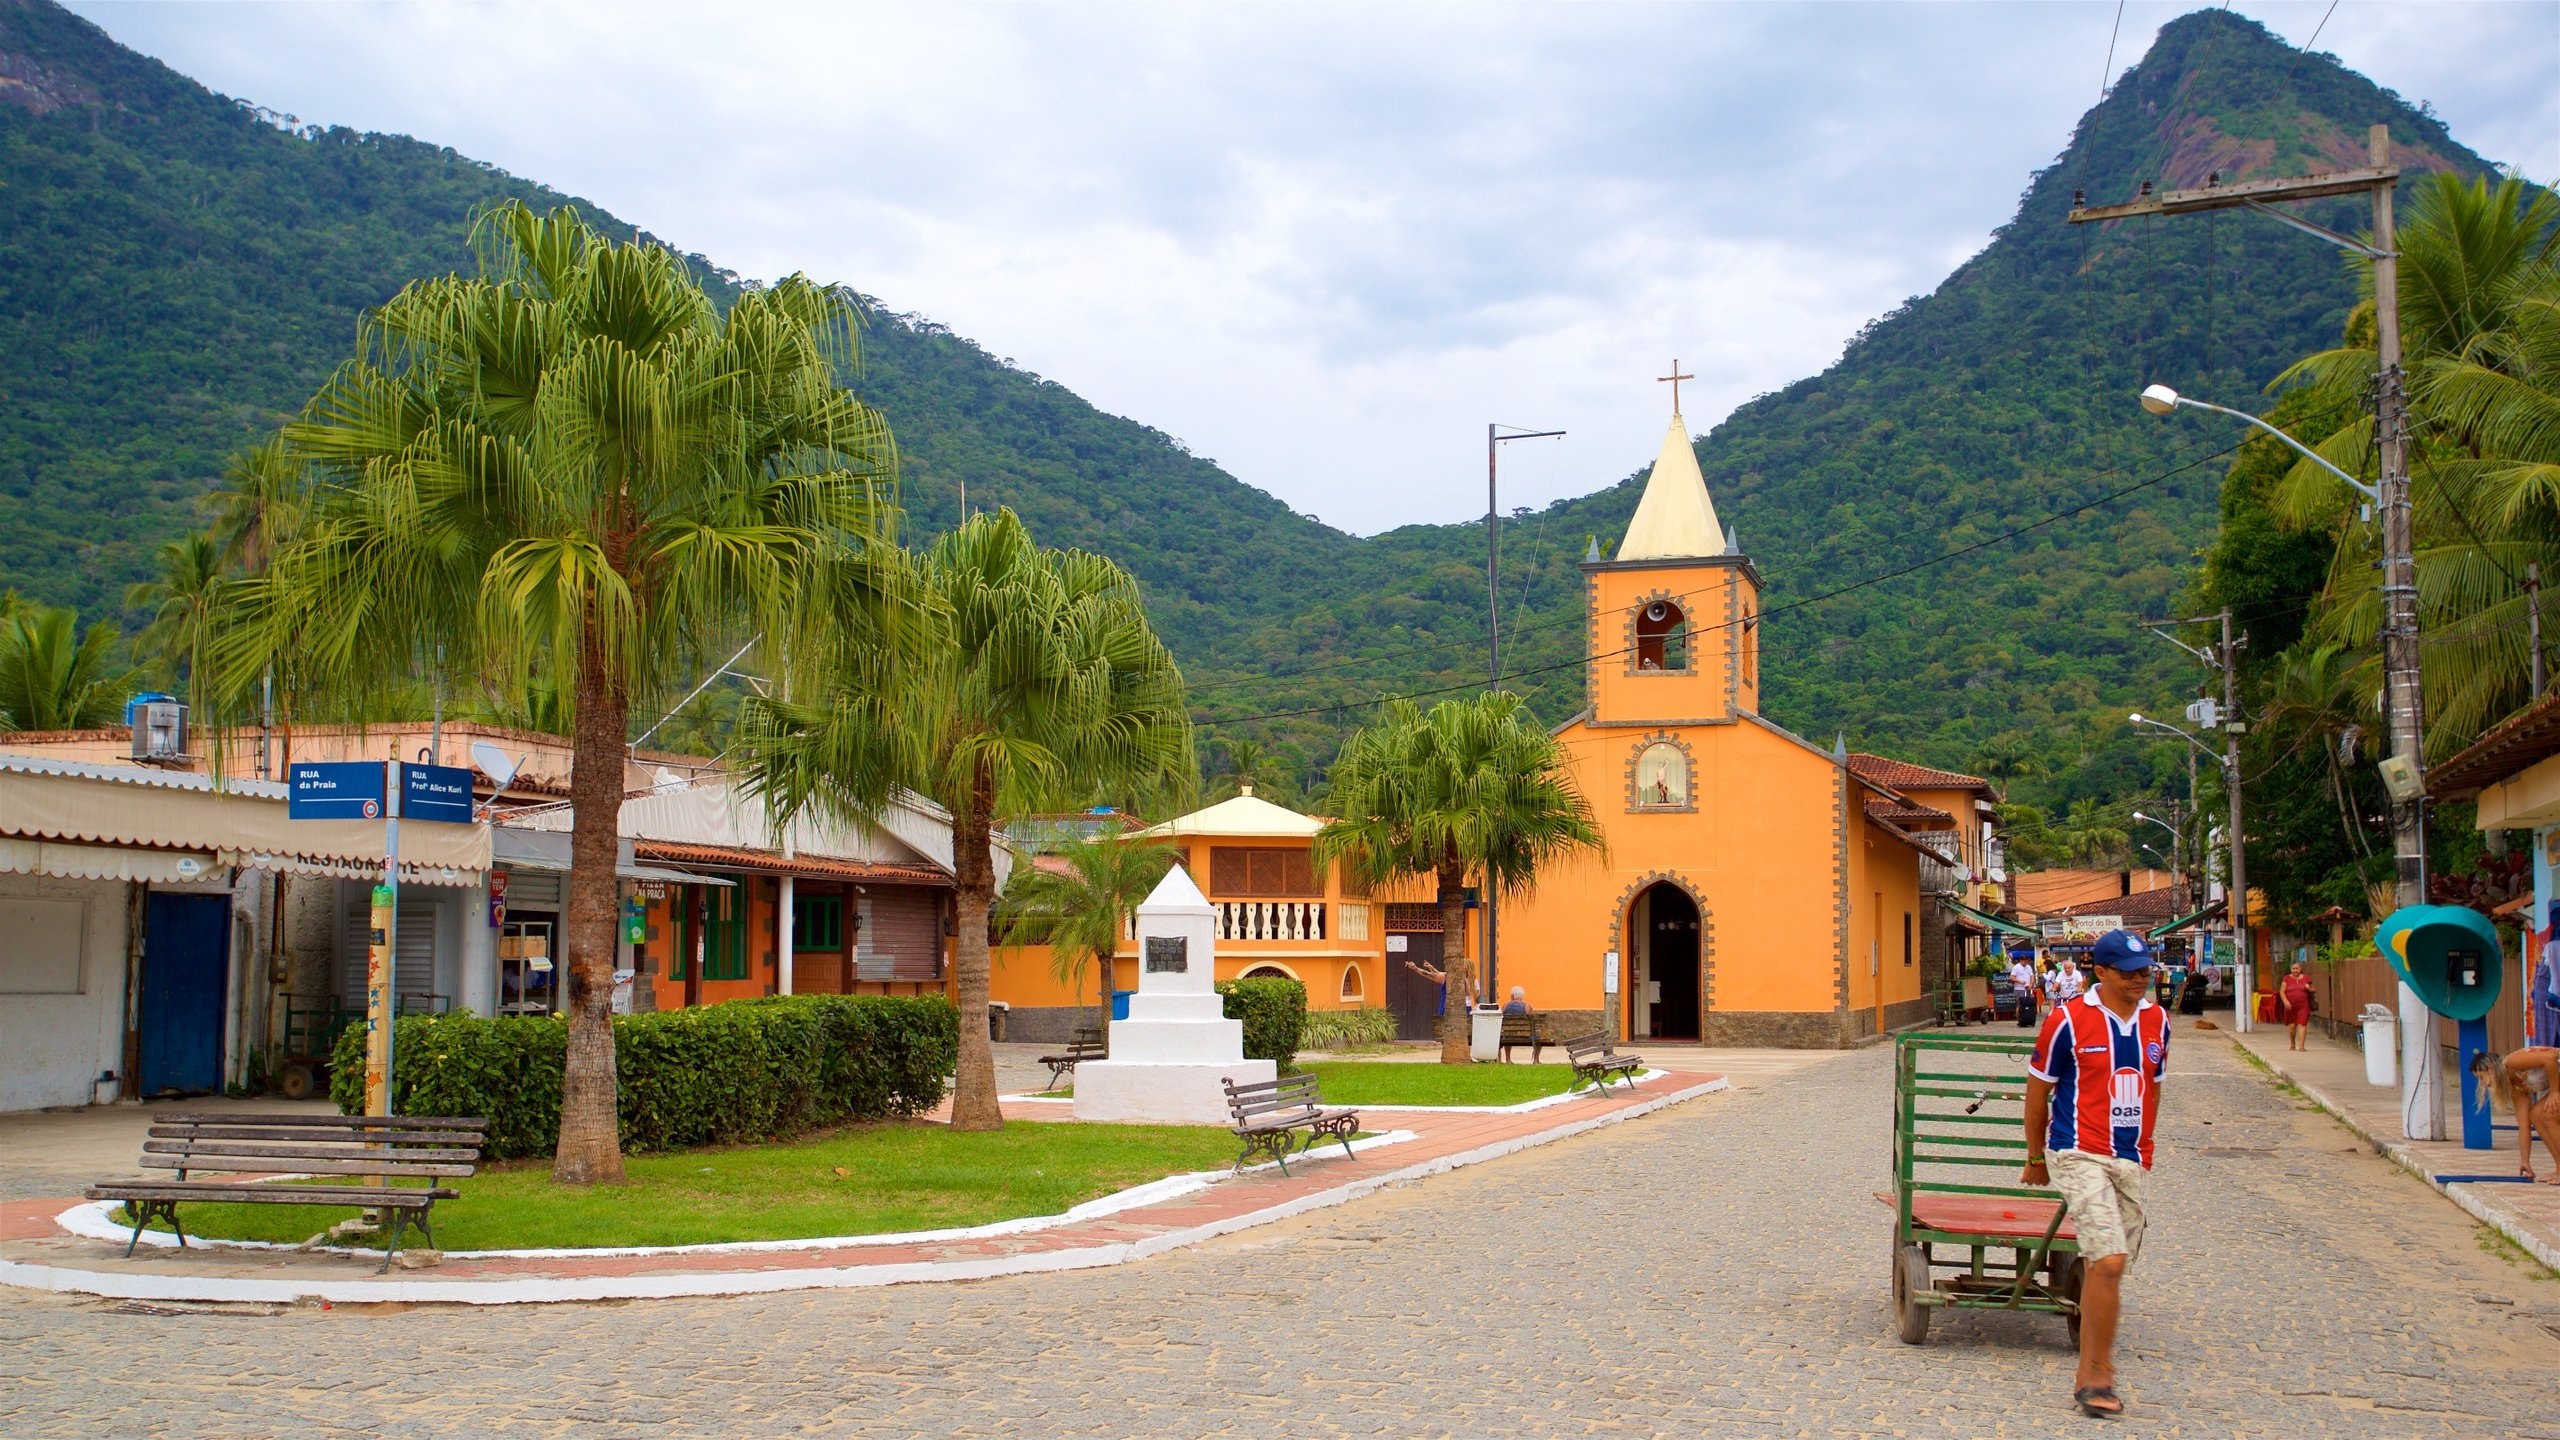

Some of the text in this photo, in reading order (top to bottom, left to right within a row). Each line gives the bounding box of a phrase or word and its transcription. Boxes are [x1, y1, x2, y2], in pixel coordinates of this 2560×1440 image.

[300, 770, 320, 779] RUA
[411, 770, 427, 780] RUA
[299, 780, 337, 789] da Praia
[429, 783, 447, 793] Alice
[297, 852, 420, 875] RESTAURATE
[2075, 919, 2117, 927] Portal da Ilha
[2111, 1106, 2141, 1117] oas
